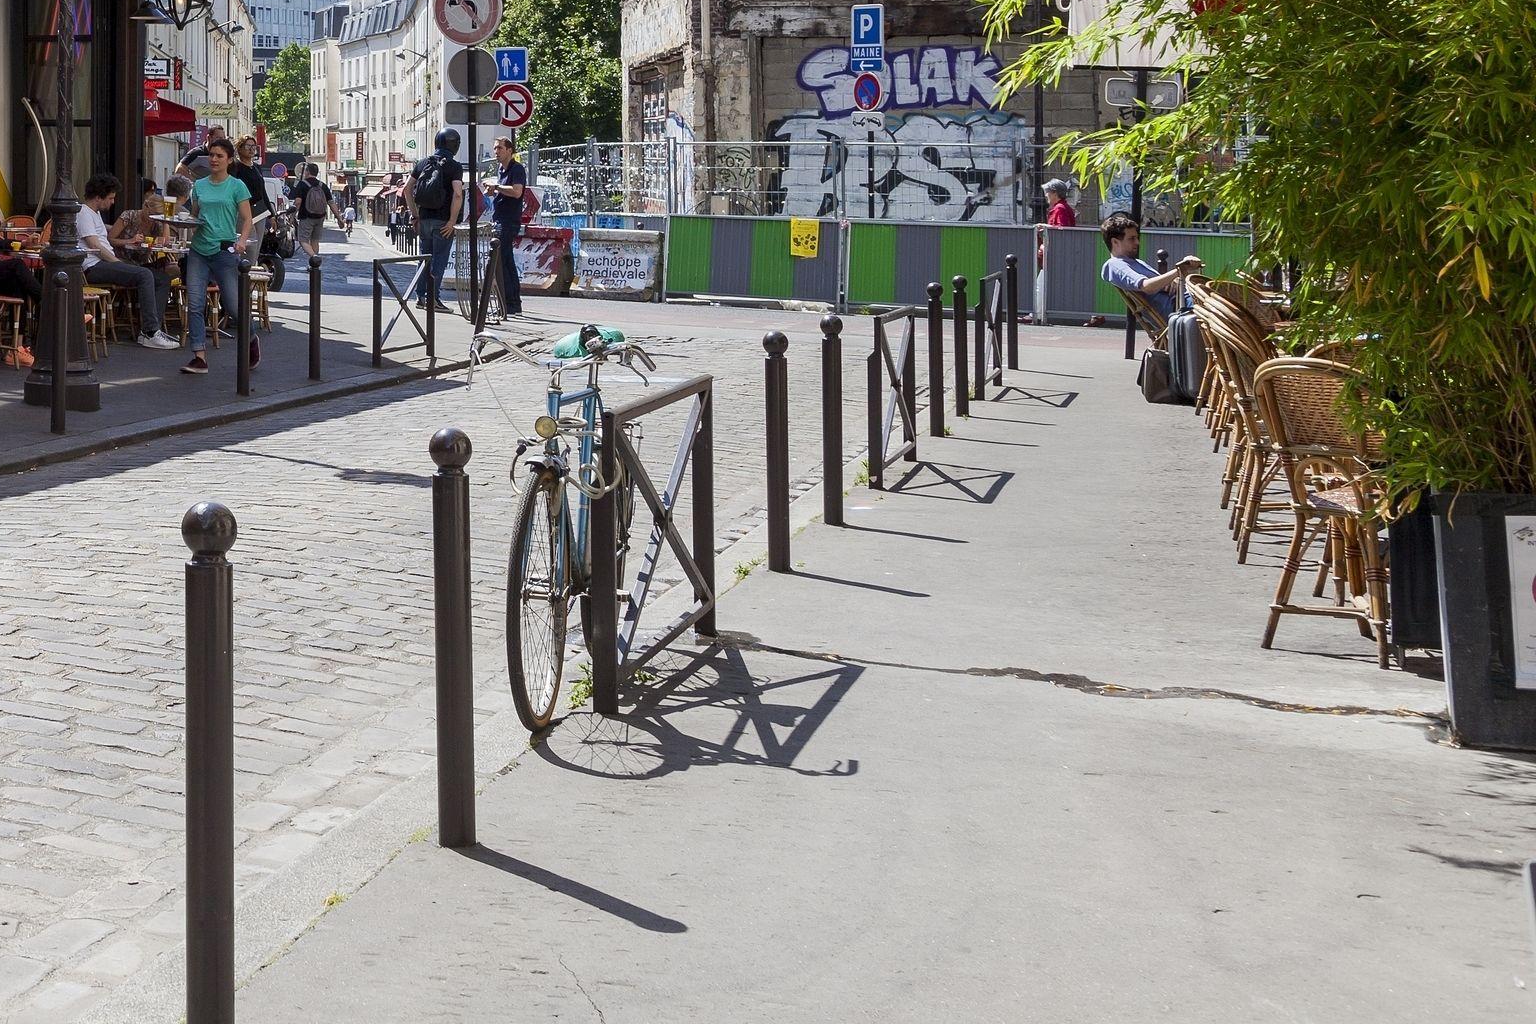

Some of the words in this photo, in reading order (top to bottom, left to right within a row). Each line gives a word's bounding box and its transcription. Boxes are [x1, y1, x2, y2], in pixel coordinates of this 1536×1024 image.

[859, 13, 874, 39] P
[853, 47, 881, 58] MAINE
[588, 256, 642, 270] echoppe
